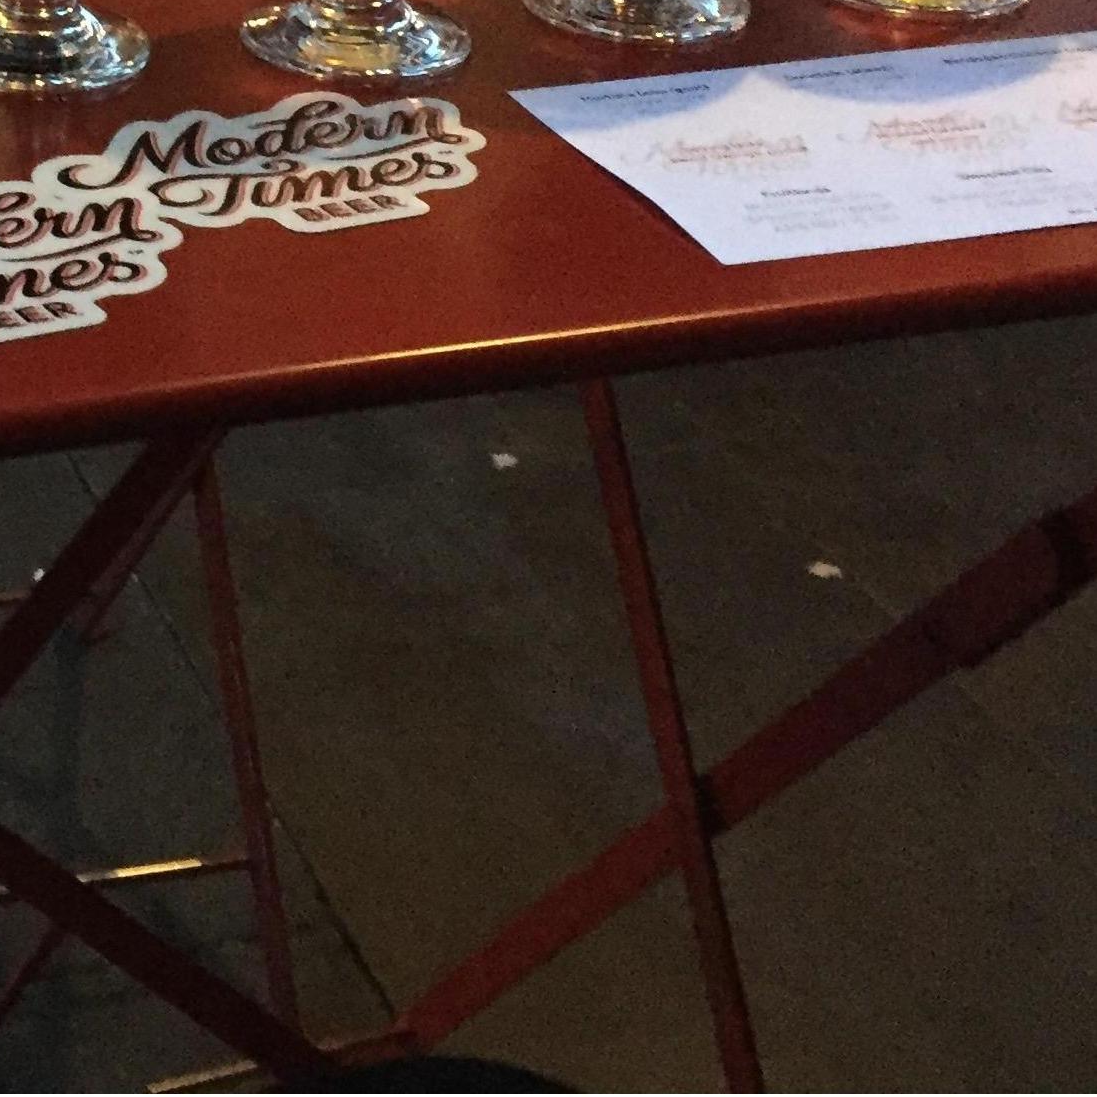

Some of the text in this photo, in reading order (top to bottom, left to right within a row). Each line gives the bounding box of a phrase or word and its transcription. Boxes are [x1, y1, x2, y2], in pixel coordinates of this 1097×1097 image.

[57, 100, 469, 191] Modern
[148, 150, 462, 217] Times
[292, 193, 409, 224] BEER
